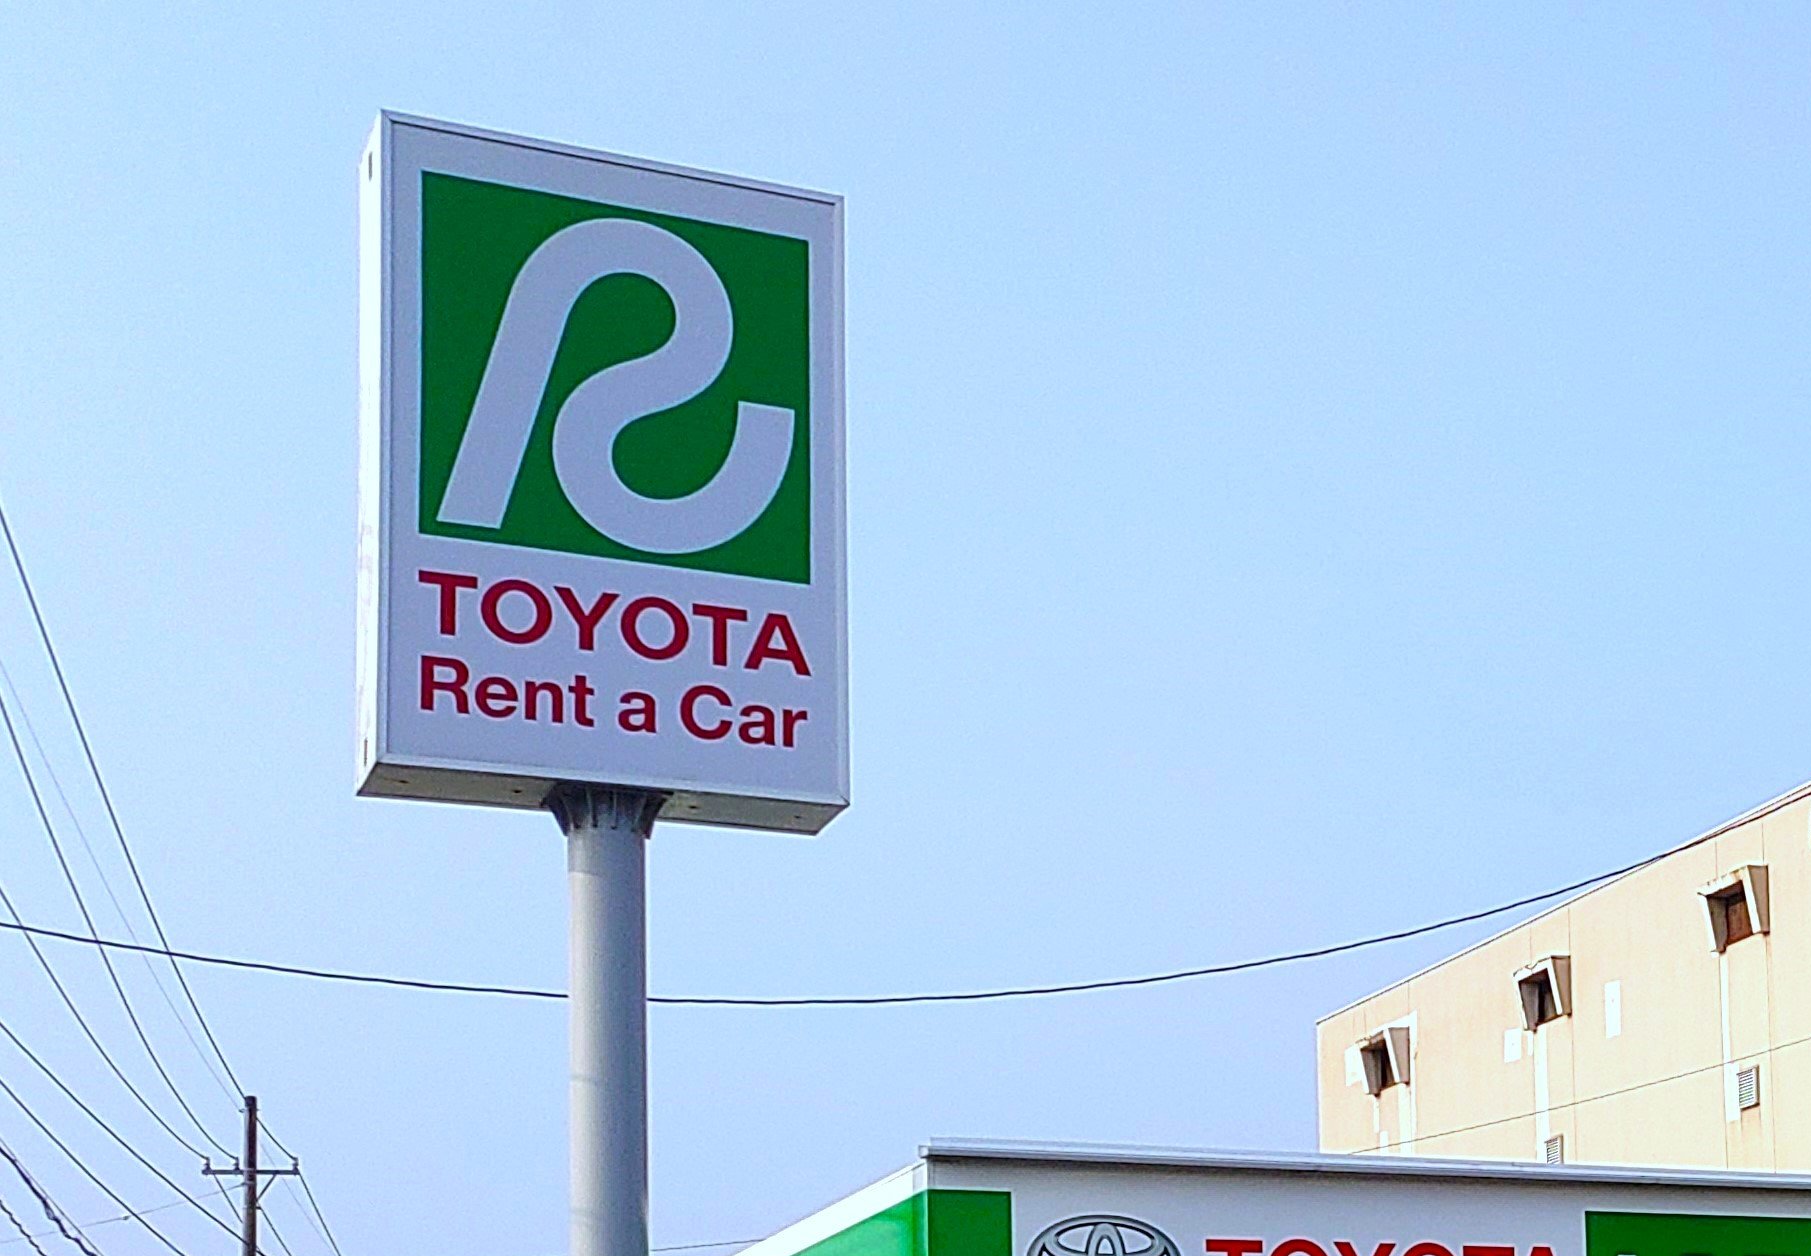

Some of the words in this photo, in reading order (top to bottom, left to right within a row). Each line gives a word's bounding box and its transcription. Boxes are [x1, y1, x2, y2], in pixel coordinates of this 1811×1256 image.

[418, 570, 812, 678] TOYOTA
[420, 655, 594, 728] Rent
[617, 692, 658, 734] a
[680, 684, 810, 749] Car
